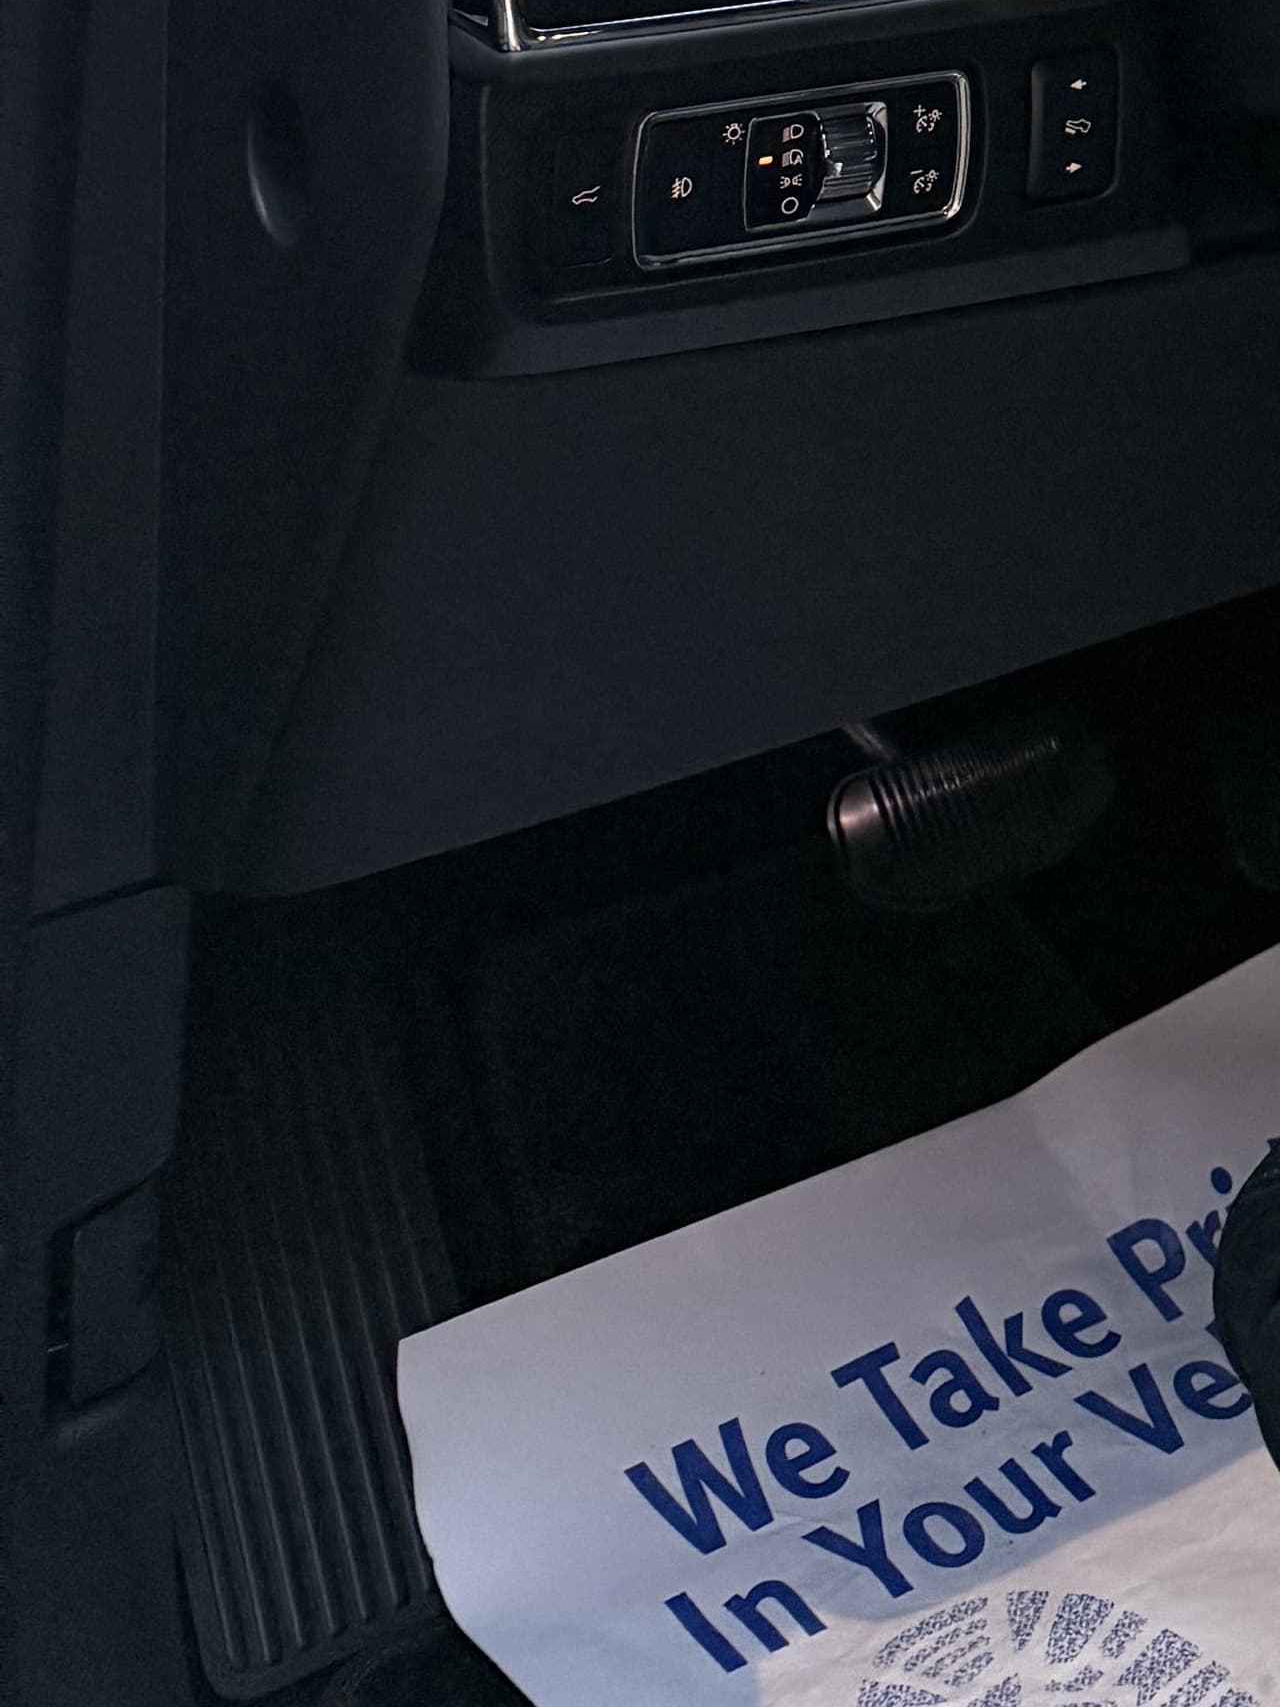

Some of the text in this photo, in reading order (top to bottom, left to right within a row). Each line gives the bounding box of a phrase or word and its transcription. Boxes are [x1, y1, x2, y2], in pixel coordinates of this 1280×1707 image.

[625, 1166, 1233, 1555] We Take Pr
[665, 1580, 827, 1674] In
[801, 1429, 1096, 1600] Your
